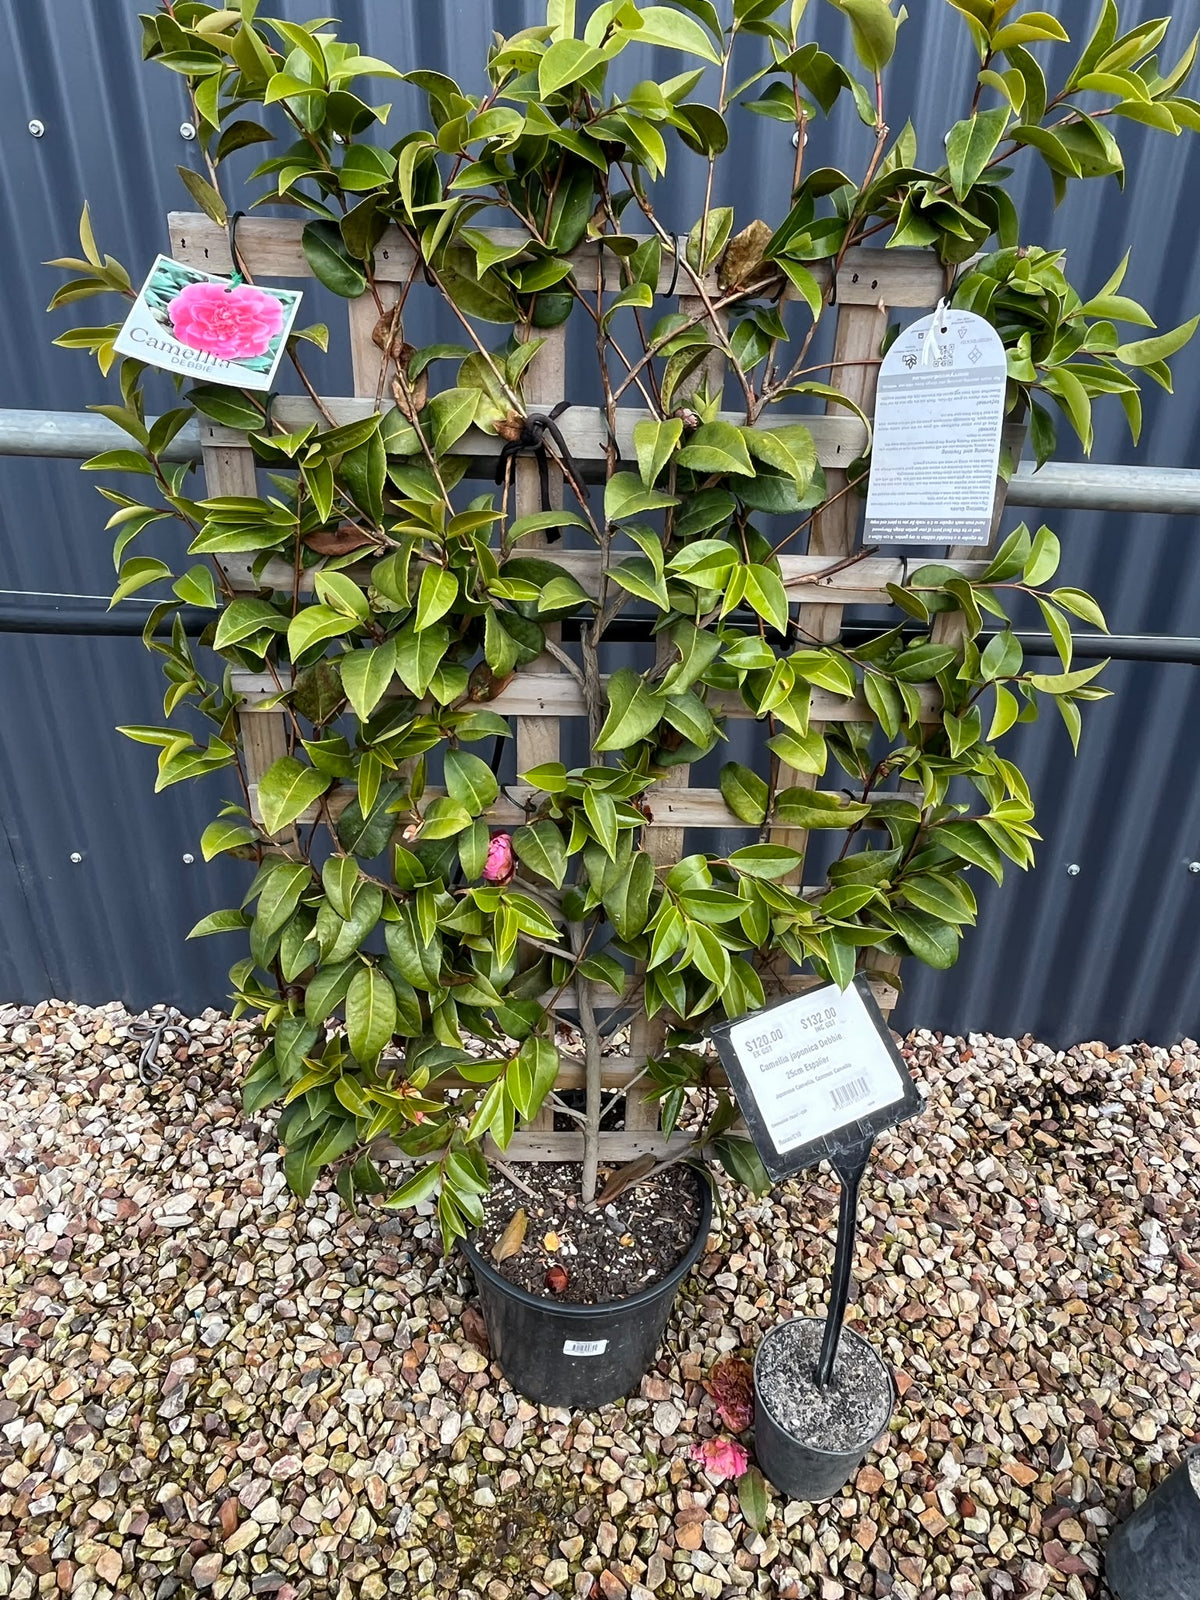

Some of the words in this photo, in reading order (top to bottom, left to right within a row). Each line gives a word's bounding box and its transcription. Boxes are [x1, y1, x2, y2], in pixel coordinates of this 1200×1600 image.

[129, 327, 230, 369] Camellia
[171, 356, 214, 373] DEBBIE
[800, 1007, 837, 1030] $132.00
[745, 1029, 783, 1052] $120.00
[760, 1055, 790, 1073] Camellia
[818, 1033, 843, 1048] Debbie
